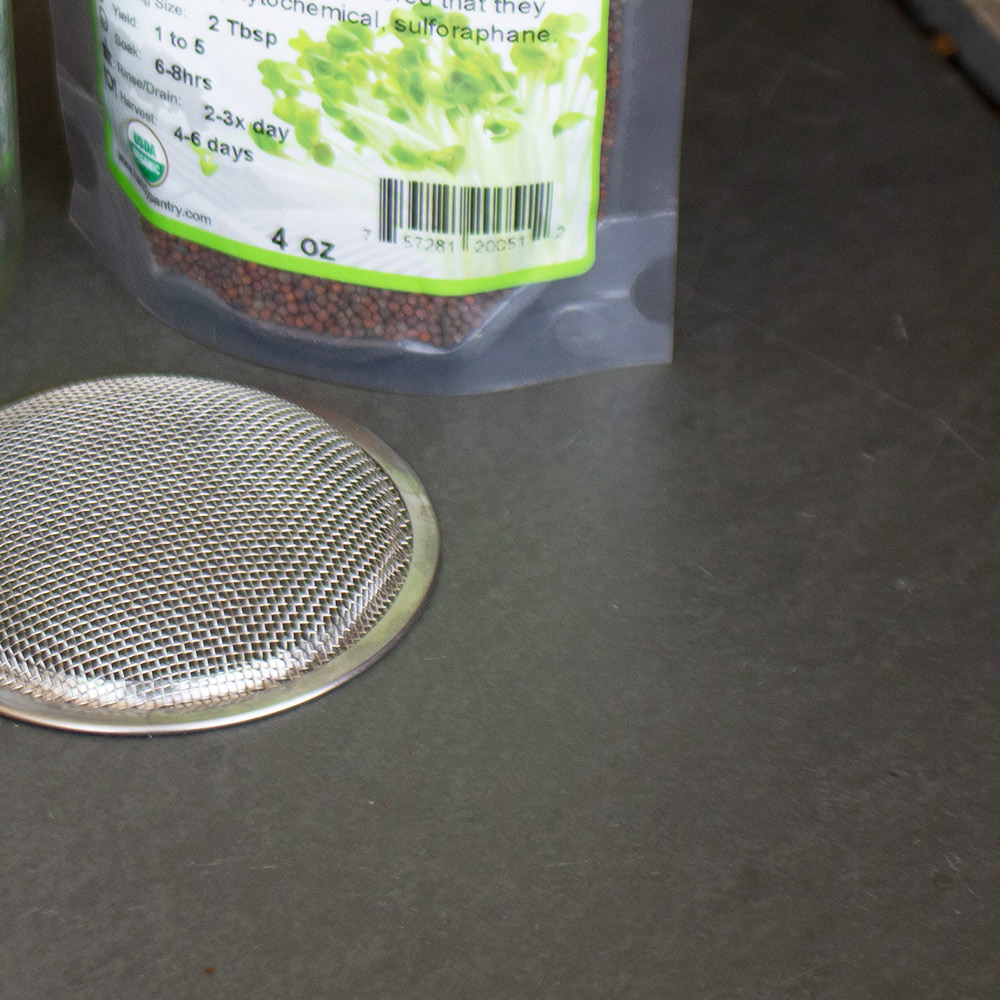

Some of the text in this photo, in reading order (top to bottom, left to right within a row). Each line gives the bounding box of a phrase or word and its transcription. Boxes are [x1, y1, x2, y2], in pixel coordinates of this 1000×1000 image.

[112, 2, 205, 55] Yield: 1 to 5
[208, 14, 219, 32] 2
[227, 18, 277, 49] Tbsp
[394, 16, 557, 45] sulforaphane.
[114, 33, 212, 91] Soak: 6-8hrs
[117, 62, 290, 143] Rinse/Drain: 2-3x day
[120, 90, 254, 163] Harvest: 4-6 days
[132, 130, 157, 159] USDA
[271, 227, 288, 250] 4
